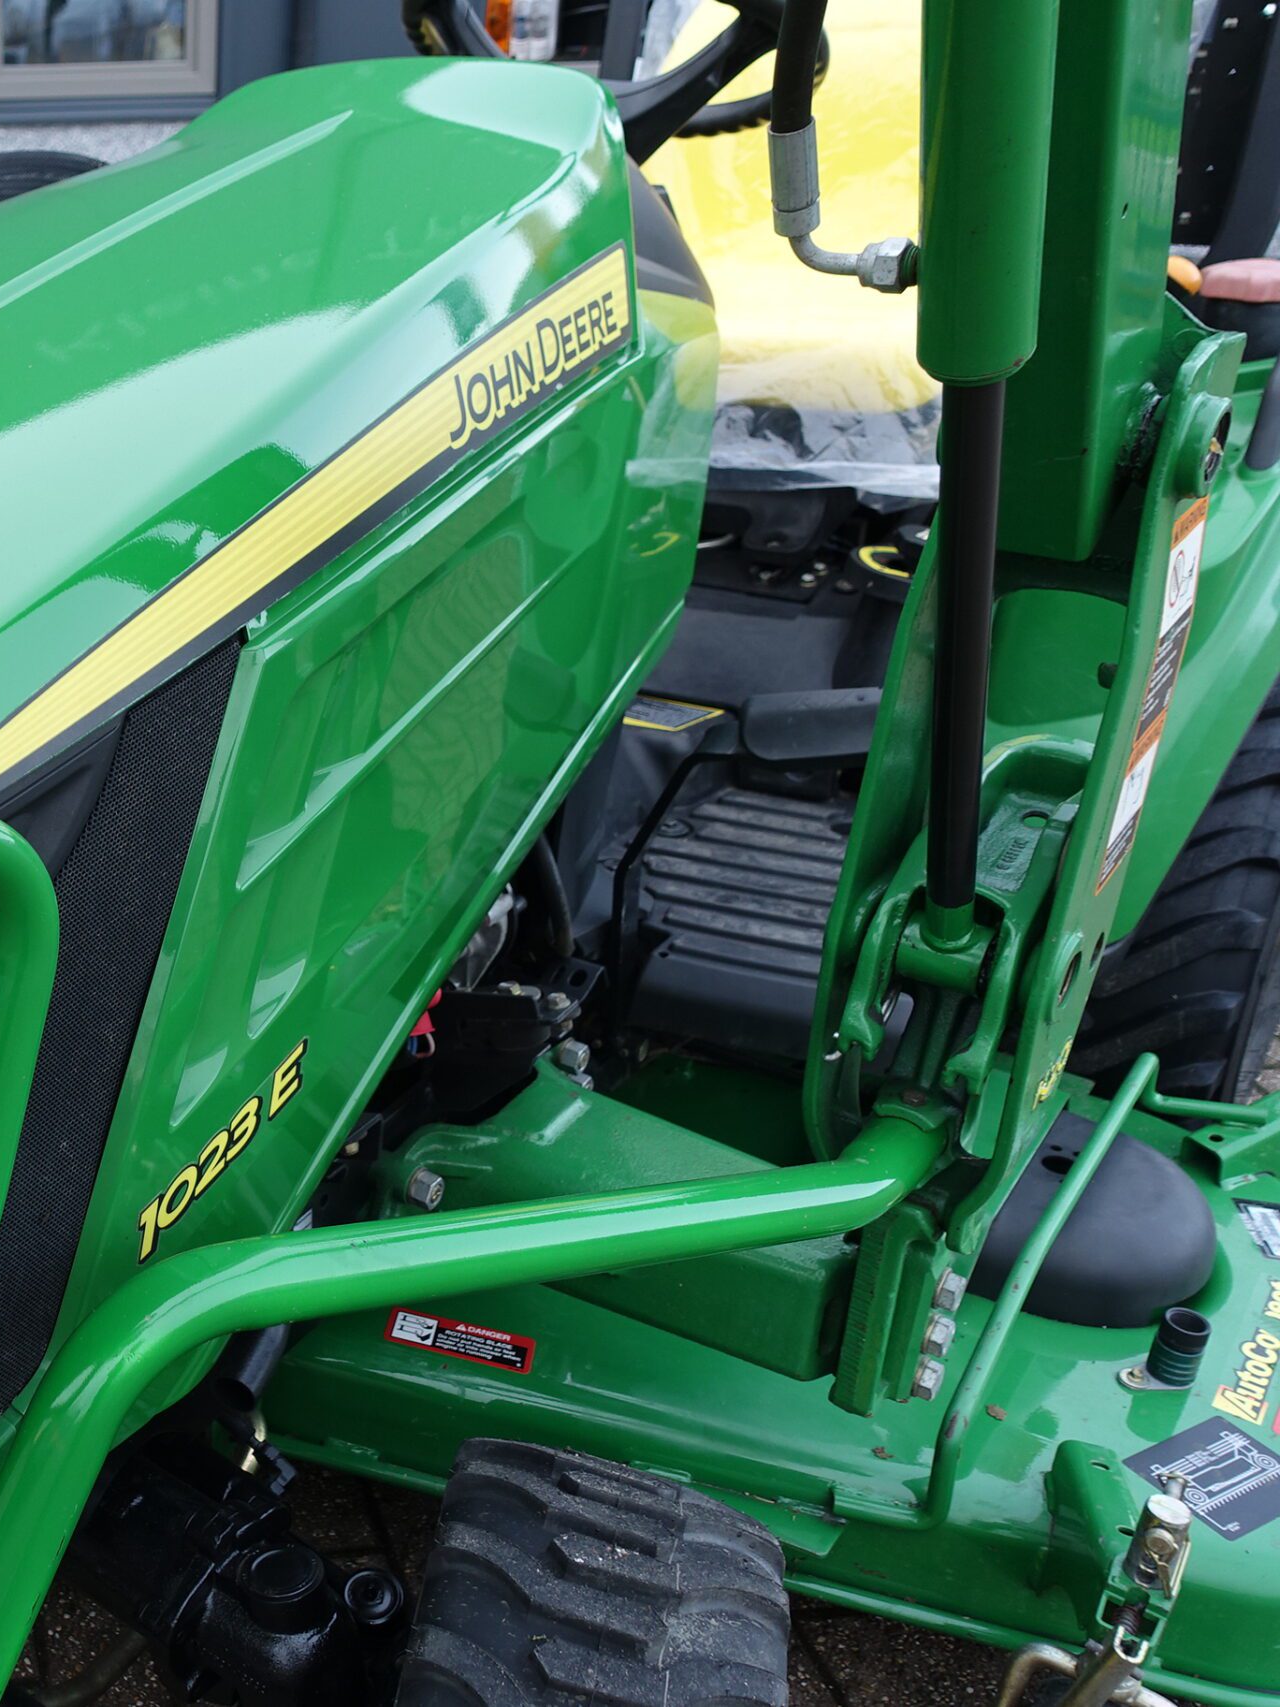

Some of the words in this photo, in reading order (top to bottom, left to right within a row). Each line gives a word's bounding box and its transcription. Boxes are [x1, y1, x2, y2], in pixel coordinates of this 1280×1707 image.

[450, 341, 536, 443] JOHN
[536, 292, 618, 377] DEERE
[138, 1095, 263, 1264] 1023
[268, 1038, 308, 1121] E
[444, 1330, 485, 1343] ROTATING
[485, 1339, 513, 1350] BLADE
[467, 1326, 511, 1341] DANGER
